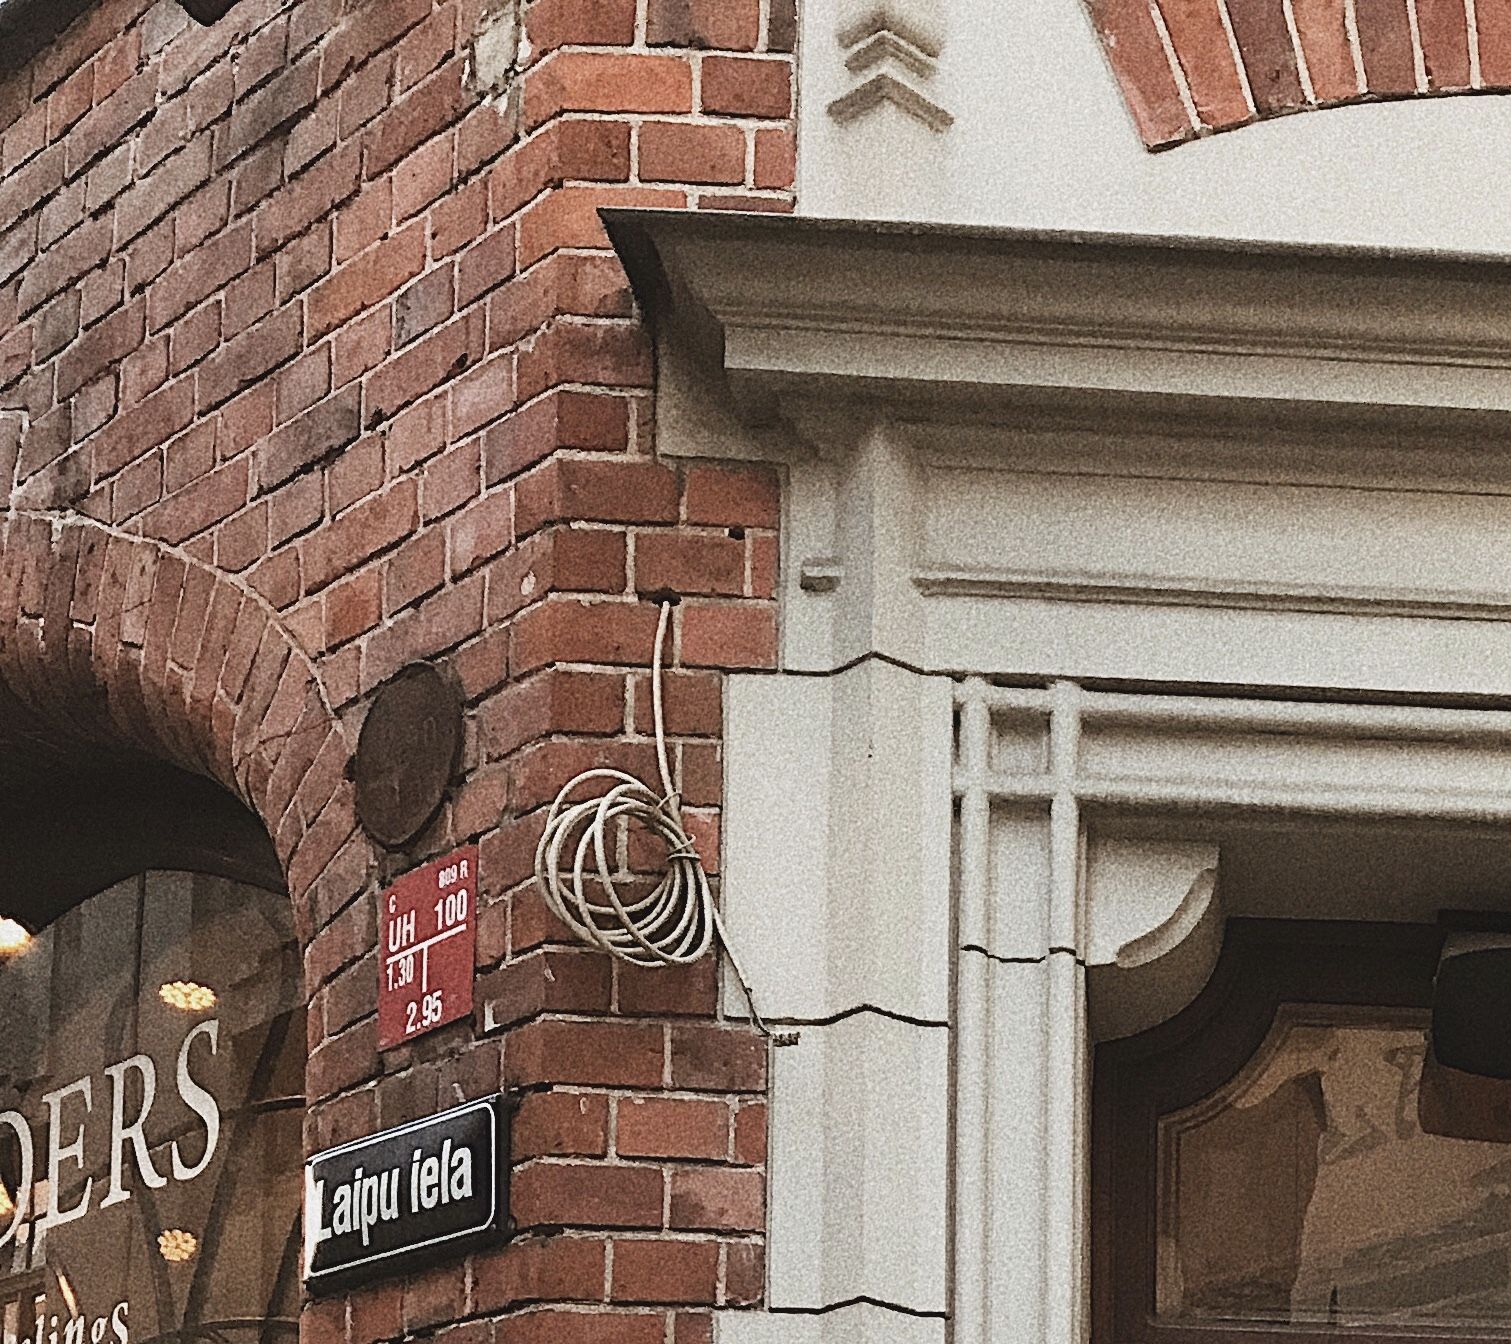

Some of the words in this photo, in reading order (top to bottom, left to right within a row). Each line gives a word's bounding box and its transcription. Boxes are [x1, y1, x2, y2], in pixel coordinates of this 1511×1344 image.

[460, 860, 468, 879] R
[388, 909, 416, 953] UH
[434, 888, 468, 931] 100
[386, 954, 415, 992] 1.30
[405, 990, 443, 1034] 2.95
[315, 1167, 400, 1247] Laipu
[410, 1138, 473, 1214] iela
